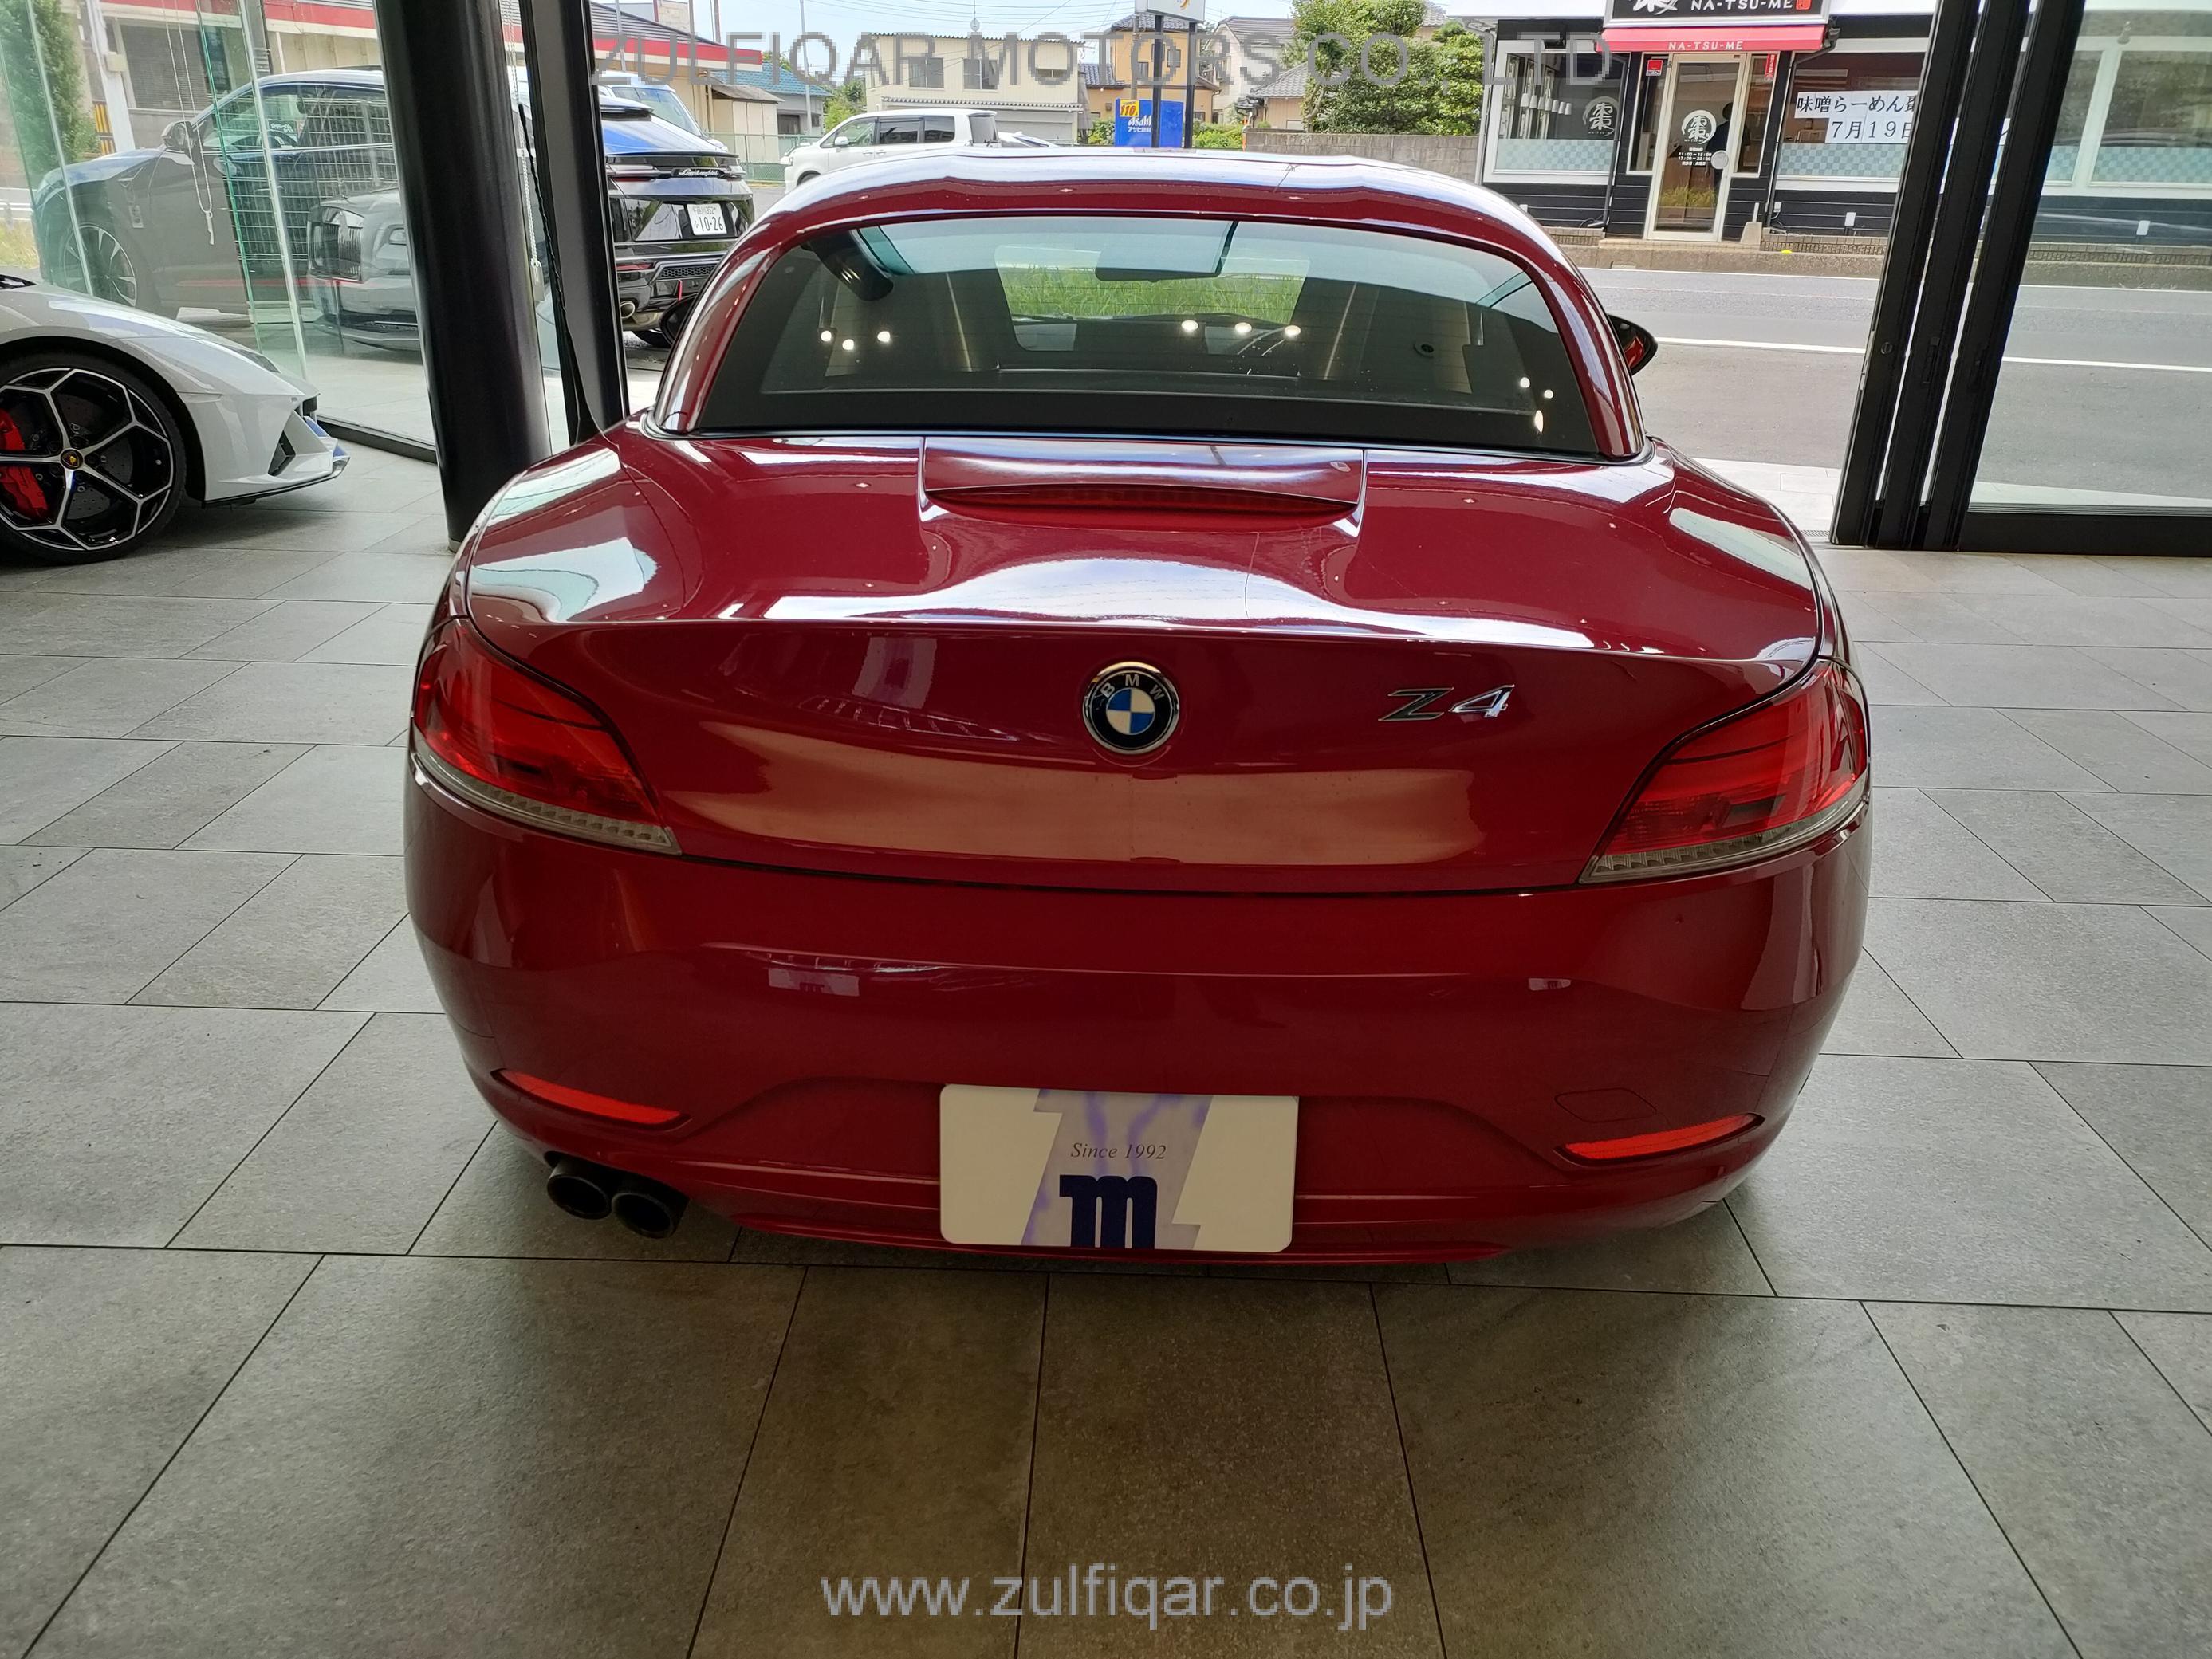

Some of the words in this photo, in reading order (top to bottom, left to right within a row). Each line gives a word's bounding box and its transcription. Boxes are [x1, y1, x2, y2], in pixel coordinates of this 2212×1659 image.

[1690, 0, 1793, 10] NA-TSU-ME
[1668, 41, 1744, 51] NA-TSU-ME
[1100, 674, 1164, 701] BMW
[1378, 684, 1515, 721] Z4
[1070, 1142, 1118, 1158] Since
[1125, 1144, 1167, 1159] 1992
